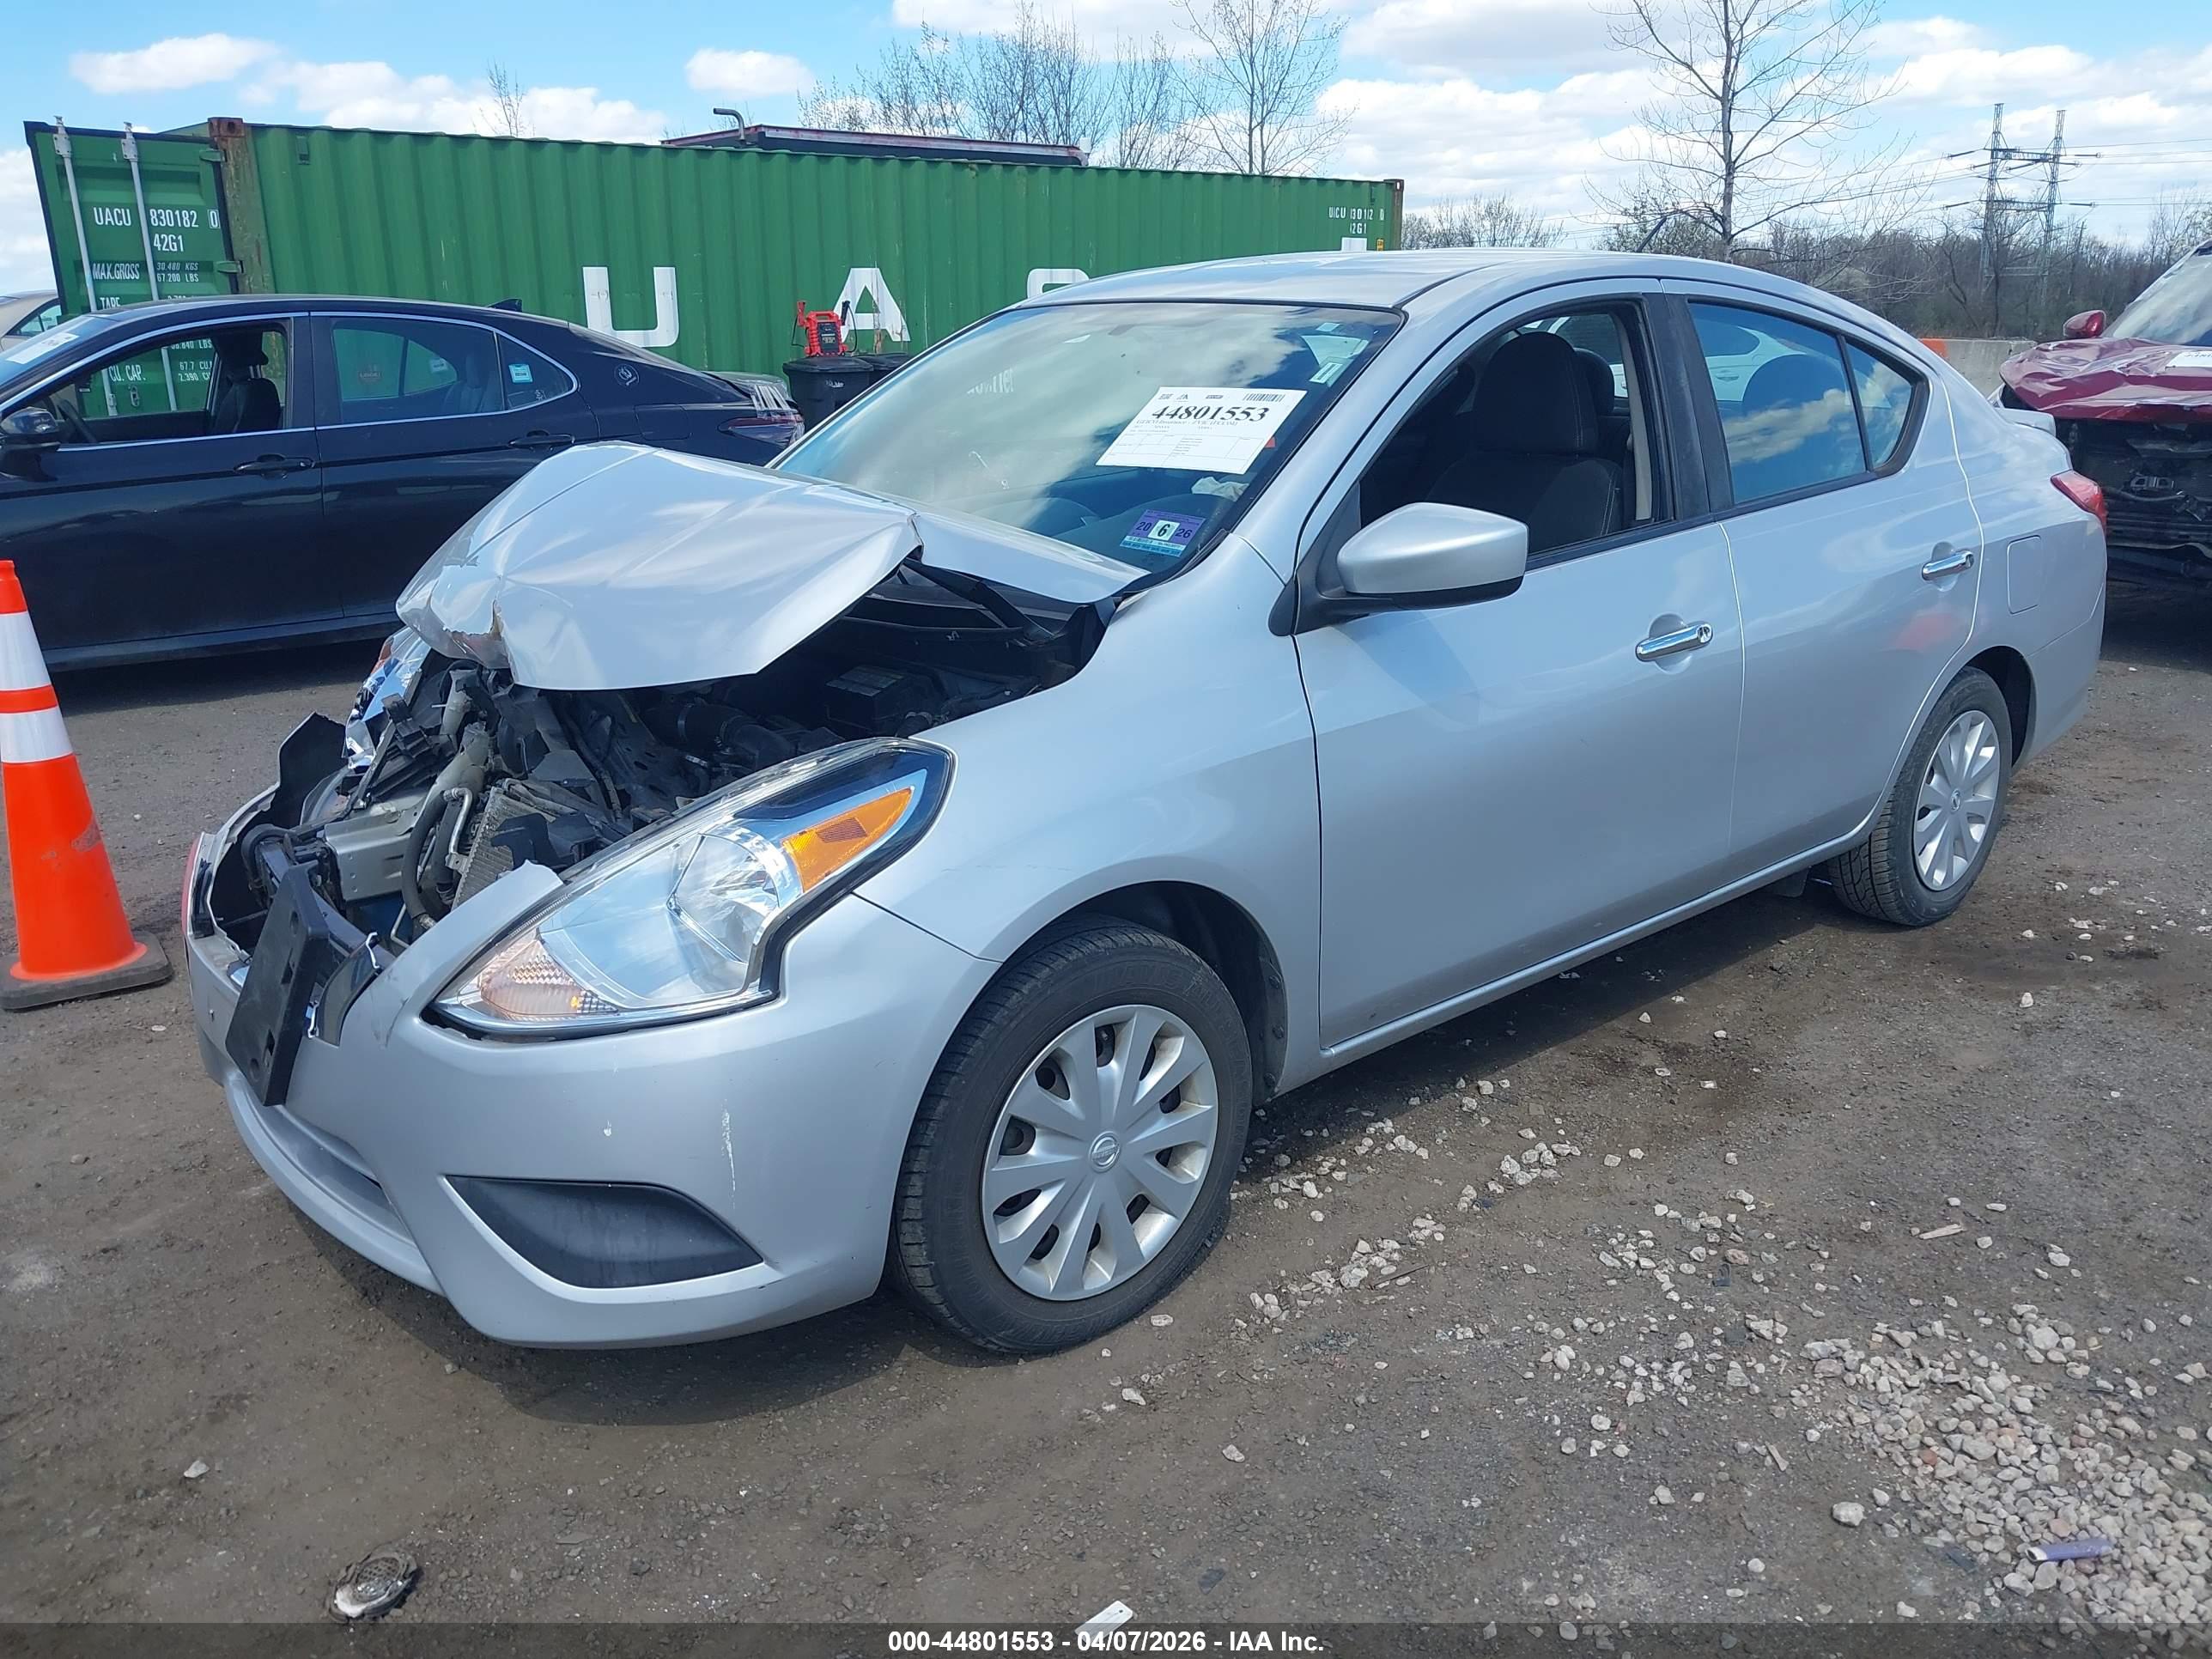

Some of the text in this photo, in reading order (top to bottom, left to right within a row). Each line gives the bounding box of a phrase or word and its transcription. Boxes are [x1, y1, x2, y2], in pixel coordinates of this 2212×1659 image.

[93, 207, 219, 228] UACU 830182 0
[1328, 206, 1346, 219] UCU
[153, 234, 185, 252] 42G1
[93, 263, 140, 280] MAX.GROSS
[185, 262, 198, 270] KGS
[185, 273, 199, 283] LBS
[1152, 405, 1270, 422] 44801553
[1135, 521, 1193, 538] 20 6 26
